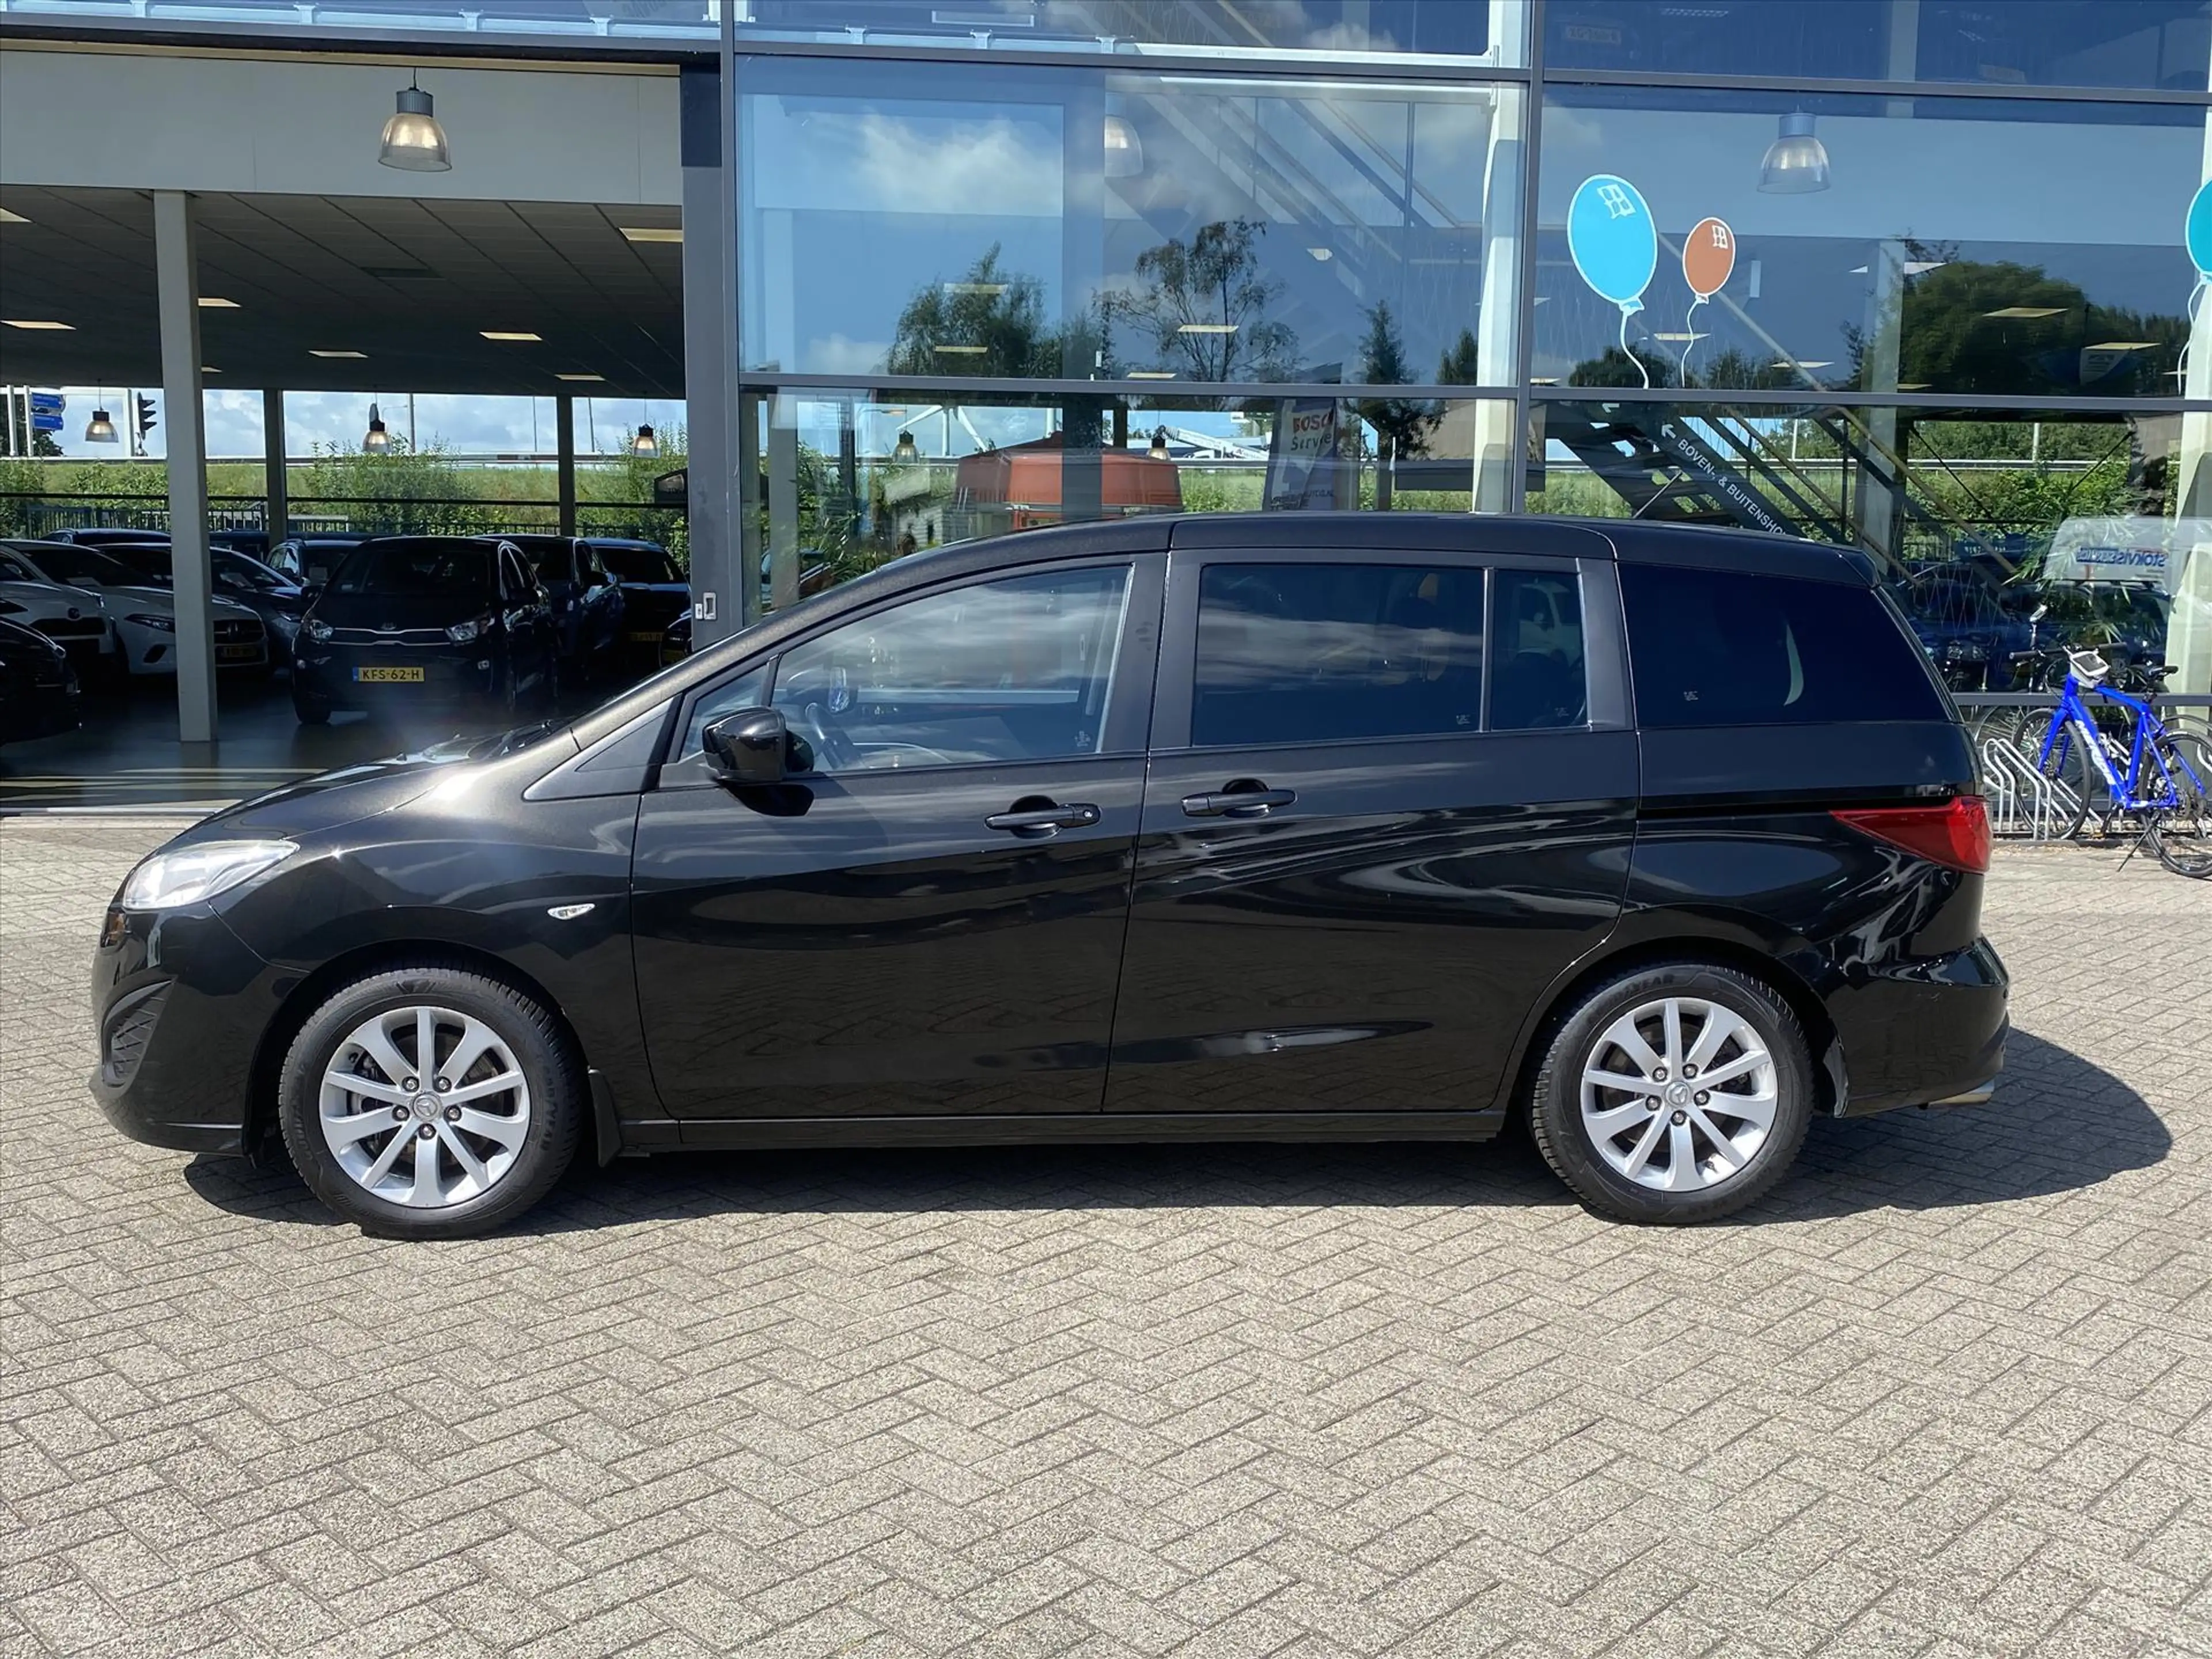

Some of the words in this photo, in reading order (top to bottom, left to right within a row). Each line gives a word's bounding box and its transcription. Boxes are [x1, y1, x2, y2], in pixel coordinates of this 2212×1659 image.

[1293, 412, 1333, 433] BOSC
[1718, 476, 1728, 487] &
[1727, 484, 1786, 535] BUITENSHO
[362, 669, 419, 680] KFS-62-H
